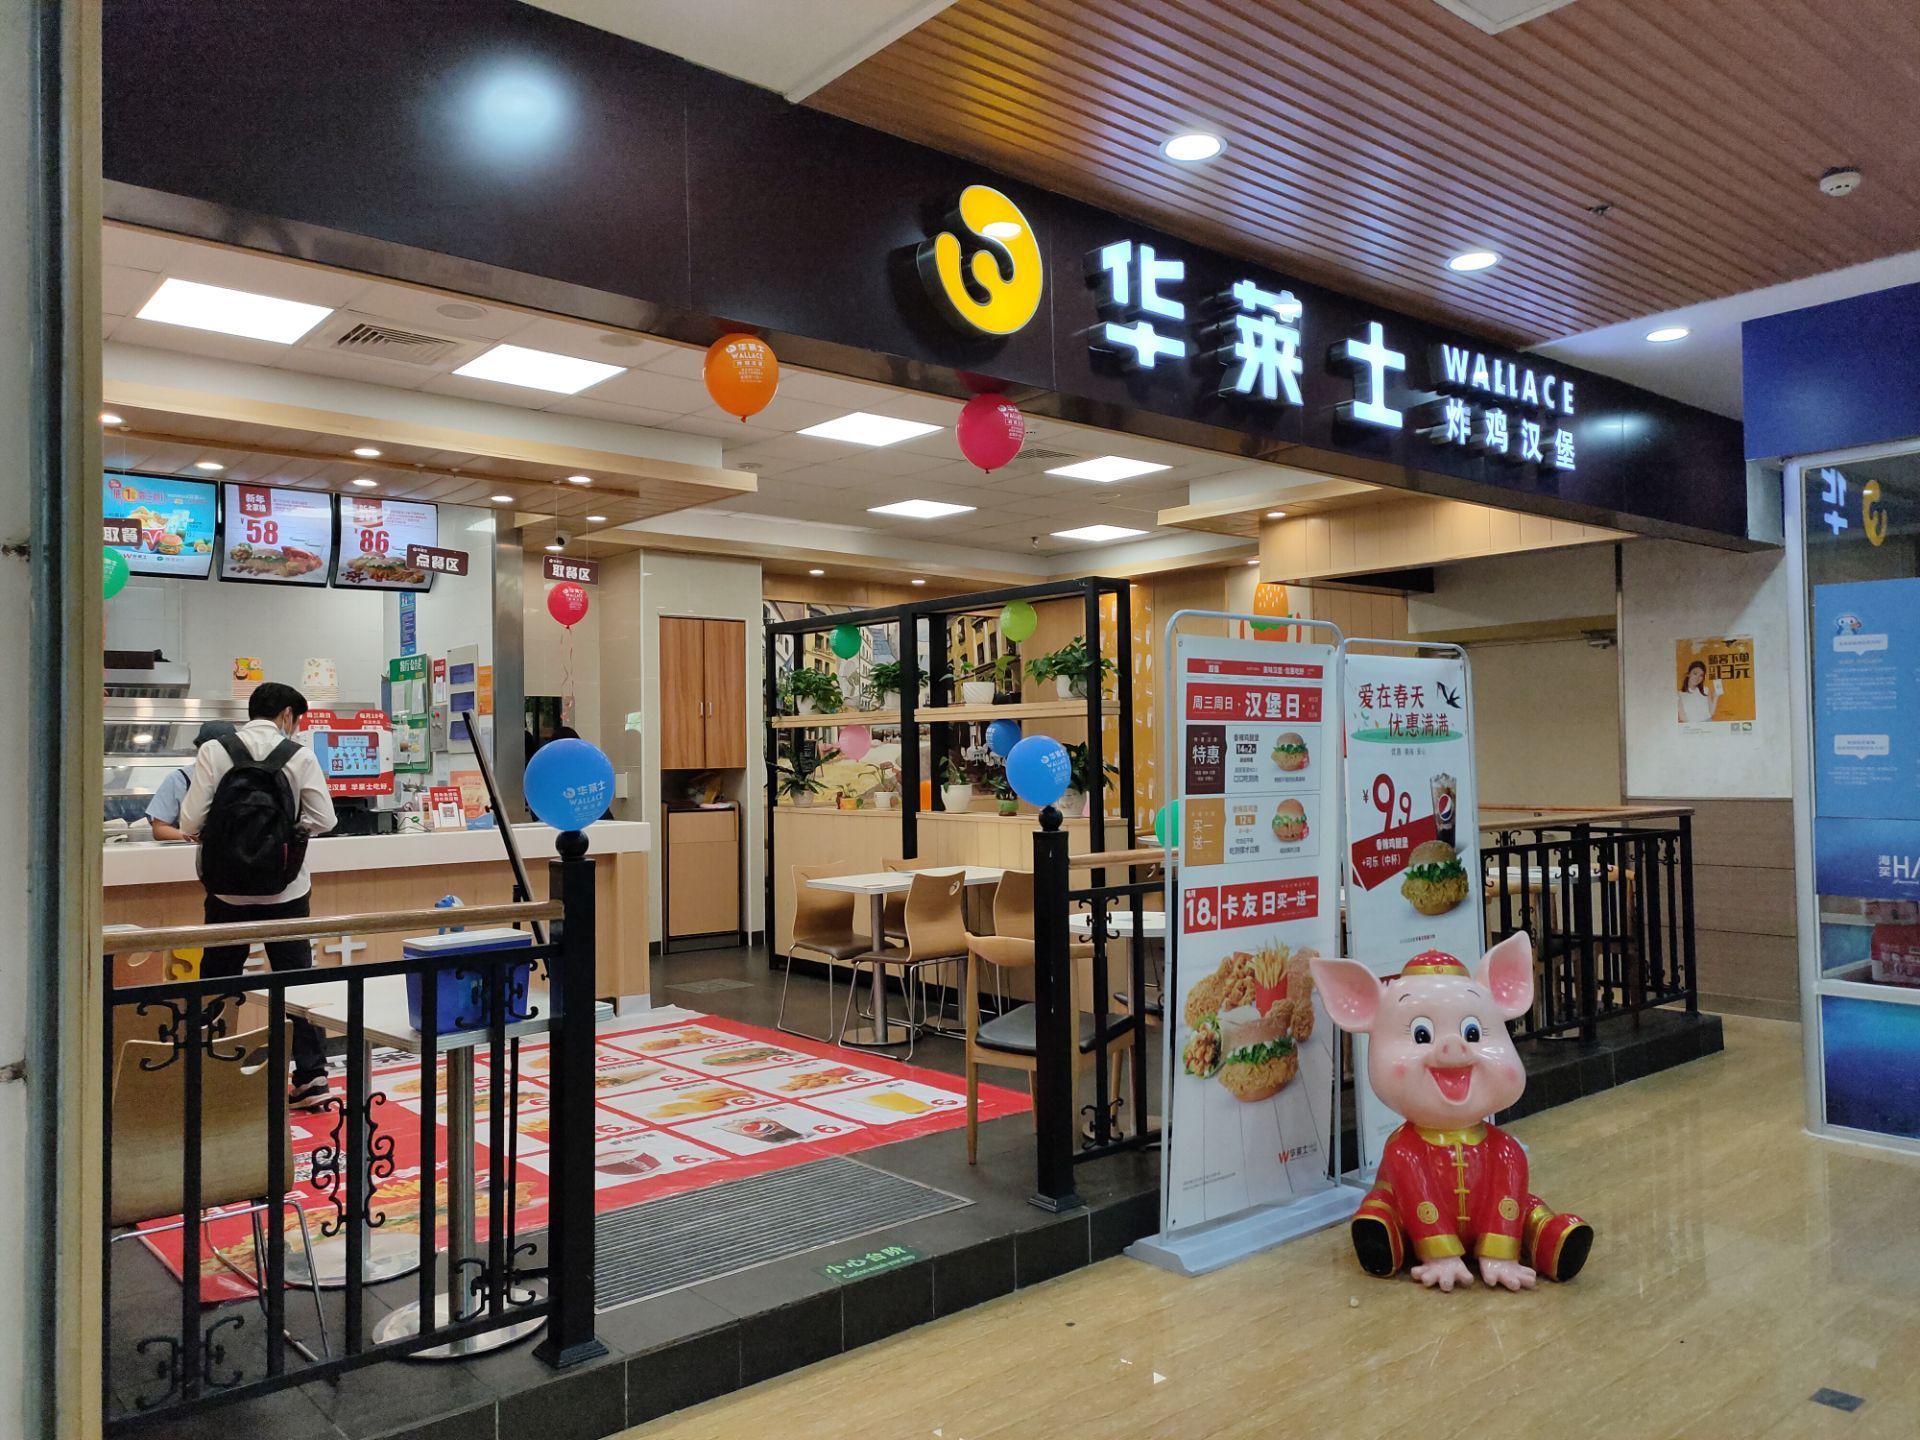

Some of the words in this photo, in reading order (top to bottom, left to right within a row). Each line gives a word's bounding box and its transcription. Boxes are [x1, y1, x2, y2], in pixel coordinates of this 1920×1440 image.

[1099, 239, 1406, 429] 华莱士
[1442, 343, 1575, 416] WALLACE
[1444, 397, 1577, 472] 炸鸡汉堡
[416, 553, 460, 572] 点餐区
[552, 563, 591, 581] 取餐区
[1245, 691, 1300, 718] 汉堡日
[1358, 683, 1425, 709] 爱在春天
[1388, 713, 1449, 737] 优惠满满
[1192, 745, 1219, 765] 特惠
[813, 1124, 842, 1134] 6
[825, 1246, 907, 1273] 小心台阶
